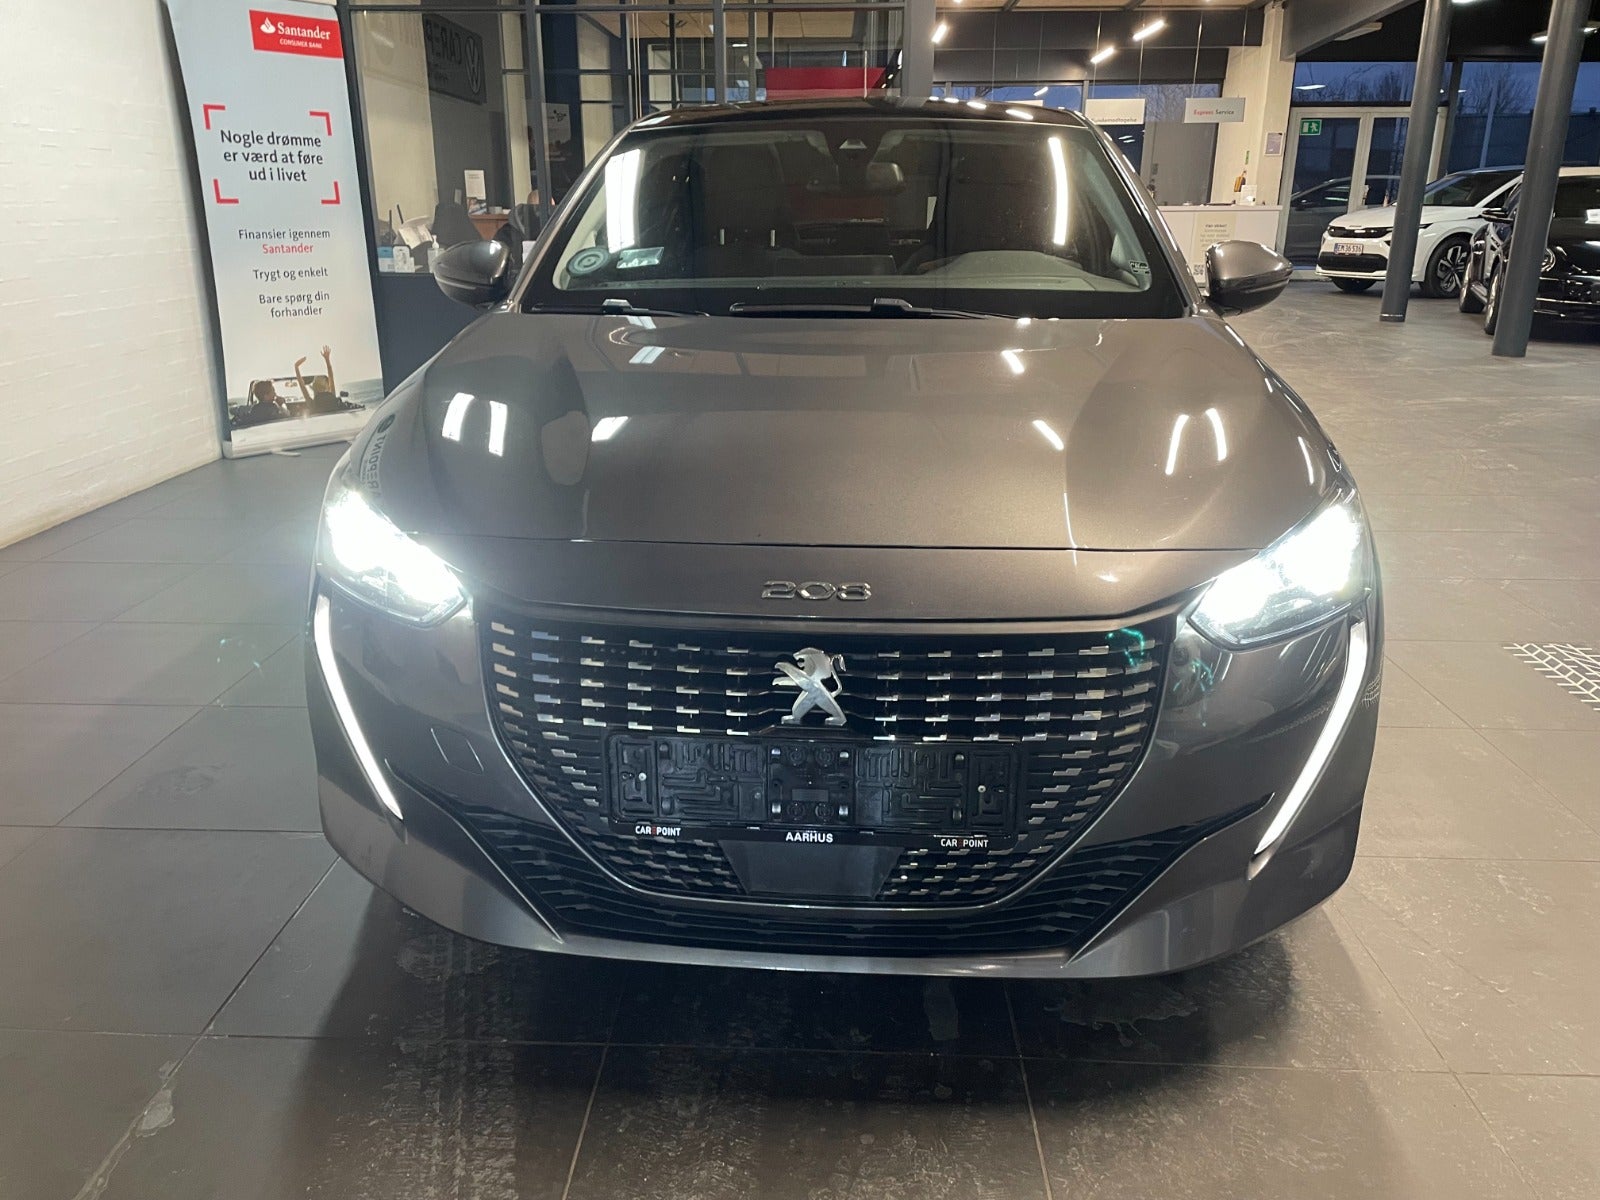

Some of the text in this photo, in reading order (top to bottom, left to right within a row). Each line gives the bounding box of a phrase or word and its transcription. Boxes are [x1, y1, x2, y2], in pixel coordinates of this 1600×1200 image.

[277, 21, 331, 40] Santander
[220, 129, 322, 148] Nogle drømme
[223, 149, 324, 165] er værd at føre
[249, 166, 308, 182] ud i livet
[238, 229, 331, 242] Finansier igennem
[262, 243, 314, 254] Santander
[253, 266, 329, 282] Trygt og enkelt
[259, 290, 330, 306] Bare spørg din
[270, 305, 323, 319] forhandler
[761, 580, 872, 601] 208
[785, 831, 834, 843] AARHUS
